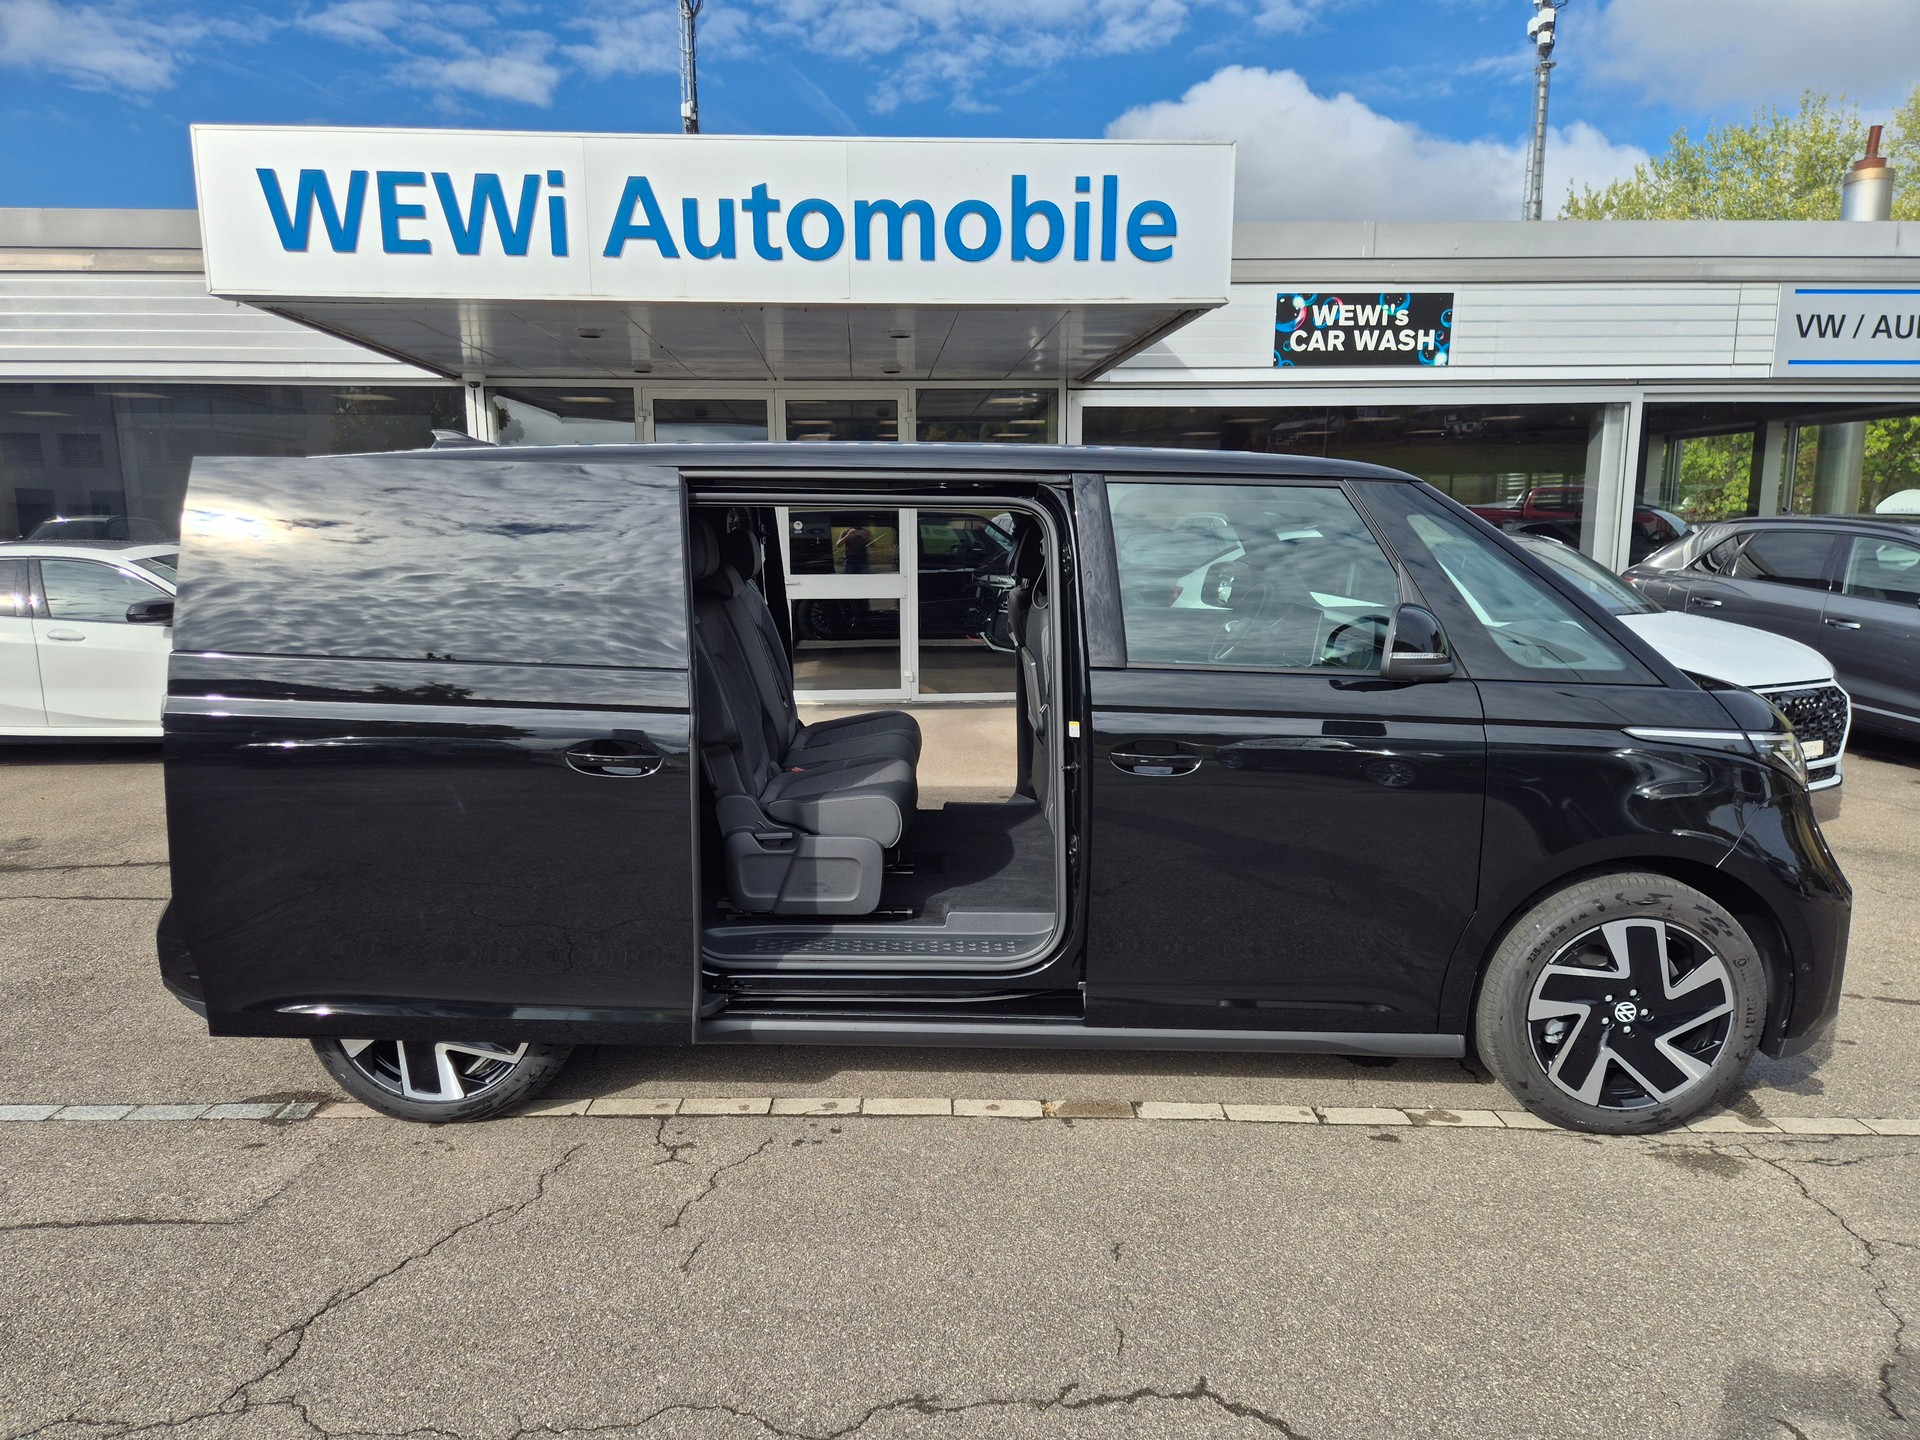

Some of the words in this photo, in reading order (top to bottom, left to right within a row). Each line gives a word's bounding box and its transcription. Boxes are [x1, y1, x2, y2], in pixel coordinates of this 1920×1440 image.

[256, 167, 569, 258] WEWi
[603, 174, 1179, 263] Automobile
[1312, 303, 1410, 327] WEWi's
[1795, 314, 1847, 339] VW
[1870, 314, 1920, 339] AU
[1289, 329, 1346, 352] CAR
[1353, 329, 1436, 352] WASH
